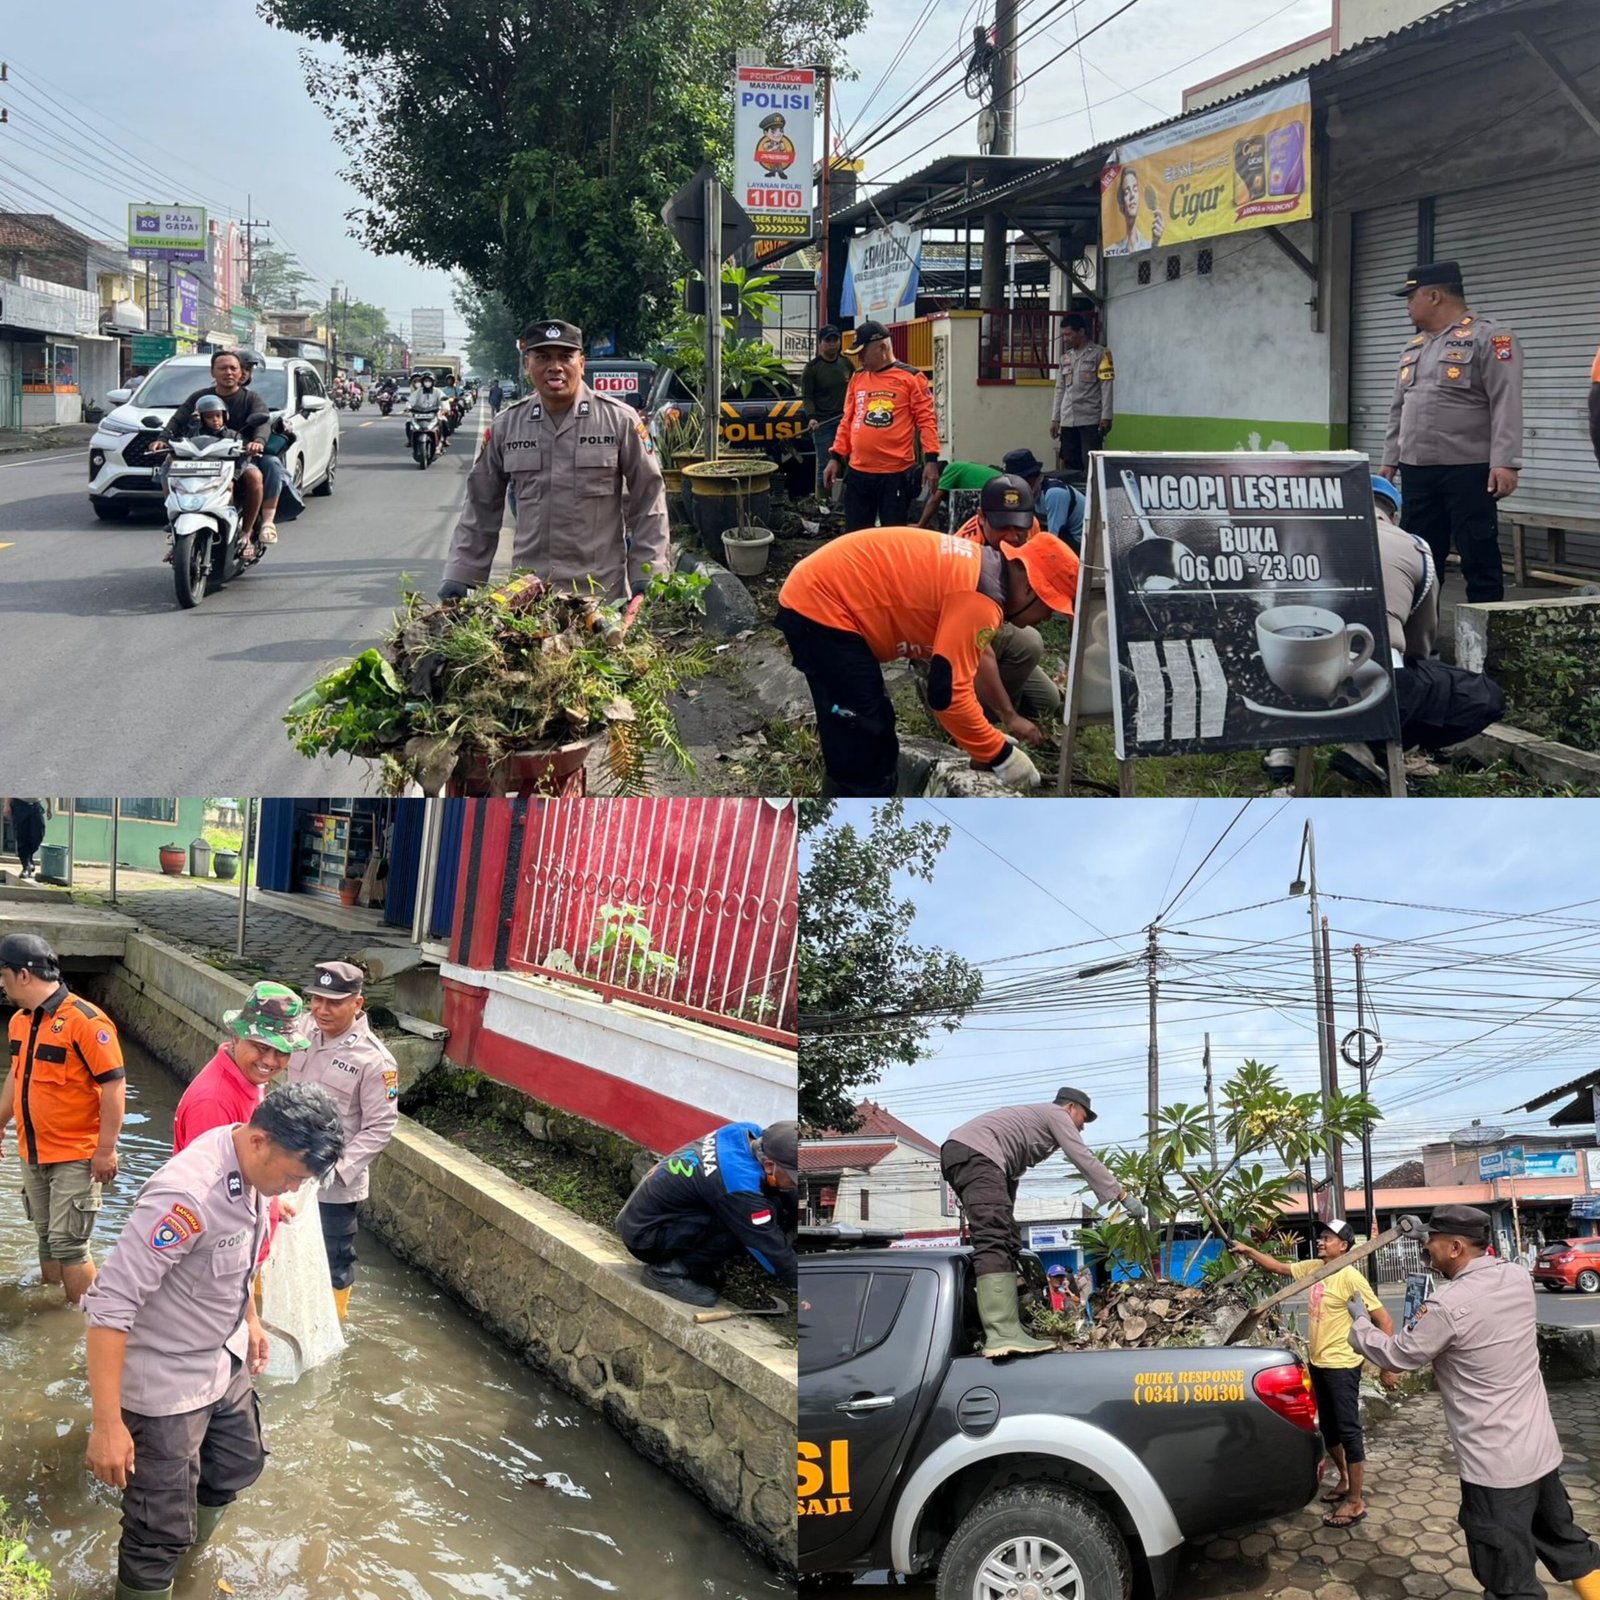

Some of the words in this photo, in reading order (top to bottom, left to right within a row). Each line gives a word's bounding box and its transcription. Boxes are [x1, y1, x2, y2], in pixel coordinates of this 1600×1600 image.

[775, 74, 802, 82] UNTUK
[749, 82, 802, 91] MASYARAKAT
[742, 92, 809, 110] POLISI
[1101, 168, 1118, 187] NEW
[751, 190, 799, 206] 110
[1169, 183, 1225, 226] Cigar
[141, 220, 156, 228] RG
[165, 214, 192, 222] RAJA
[772, 216, 807, 224] PAKISAJI
[165, 223, 199, 231] GADAI
[1444, 340, 1473, 348] POLRI
[598, 379, 635, 390] 110
[506, 440, 537, 450] TOTOK
[579, 436, 615, 445] POLRI
[1139, 475, 1226, 510] NGOPI
[1231, 476, 1344, 510] LESEHAN
[1219, 527, 1279, 553] BUKA
[1179, 555, 1244, 582] 06.00
[1260, 555, 1321, 582] 23.00
[332, 1058, 360, 1076] POLRI
[174, 1205, 200, 1231] BAHARKAM
[1134, 1372, 1174, 1385] QUICK
[1178, 1370, 1244, 1384] RESPONSE
[1193, 1384, 1245, 1402] 801301
